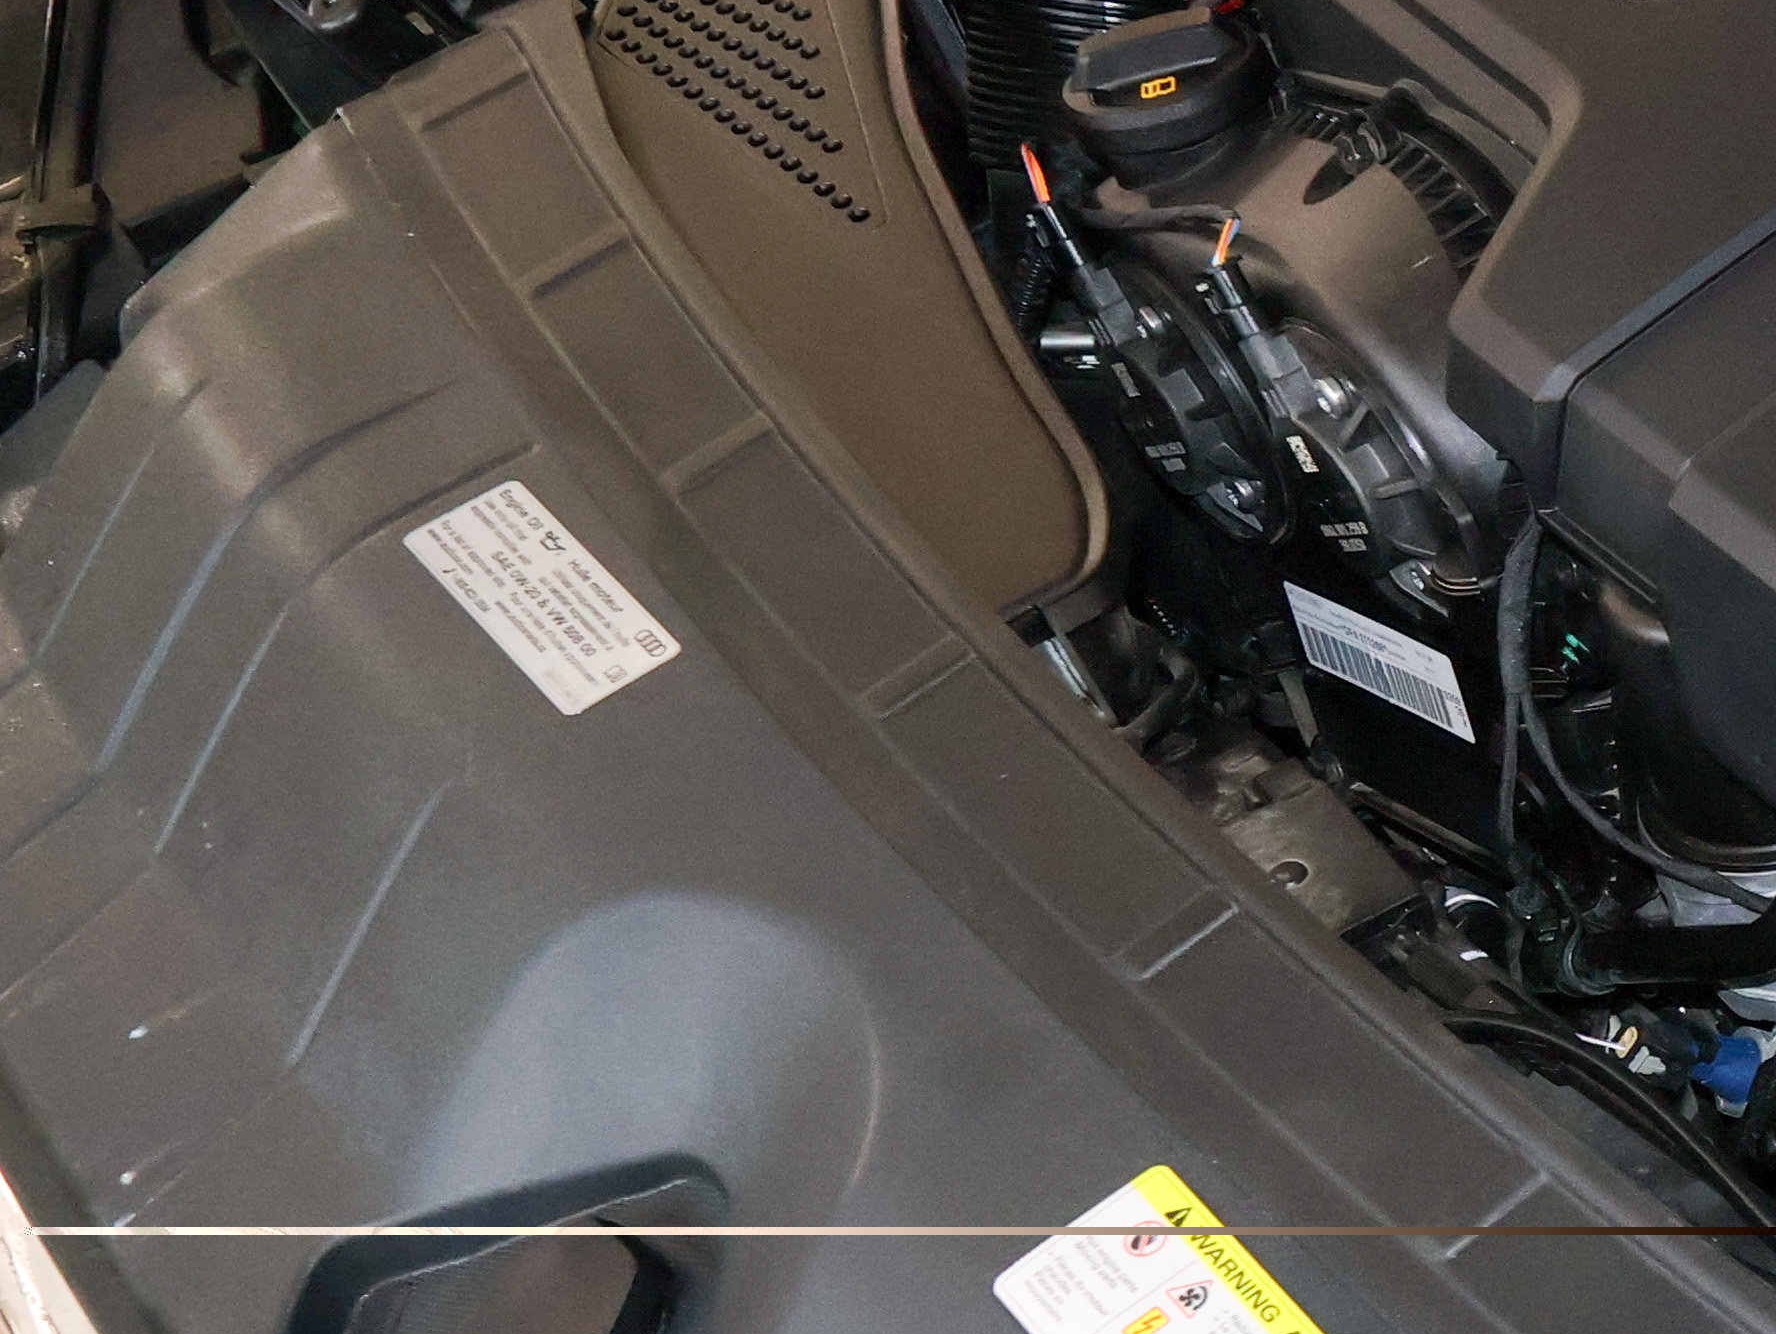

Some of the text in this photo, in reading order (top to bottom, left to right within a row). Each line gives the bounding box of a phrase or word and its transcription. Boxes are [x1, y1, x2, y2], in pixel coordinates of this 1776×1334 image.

[490, 550, 515, 572] SAE
[546, 609, 567, 625] VW
[1189, 1225, 1277, 1323] WARNING
